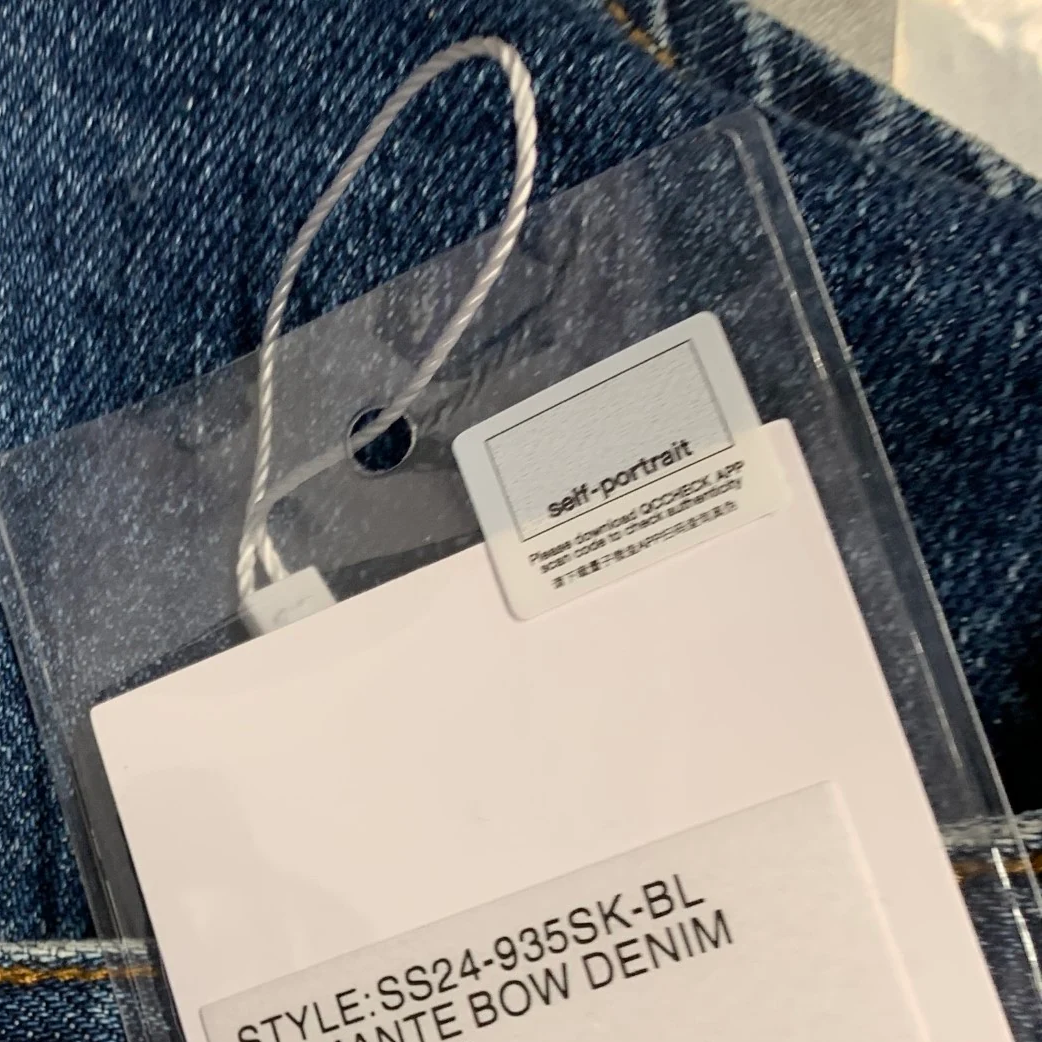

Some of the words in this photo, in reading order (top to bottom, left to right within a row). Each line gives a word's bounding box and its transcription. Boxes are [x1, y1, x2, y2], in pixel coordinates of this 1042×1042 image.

[528, 539, 573, 567] Please
[574, 507, 639, 546] download
[716, 459, 746, 481] APP
[540, 553, 571, 575] scan
[573, 536, 607, 559] code
[608, 529, 623, 544] to
[624, 510, 663, 537] check
[666, 476, 743, 518] authenticity
[547, 439, 694, 519] self-portrait
[467, 962, 570, 1029] BOW
[581, 908, 734, 990] DENIM
